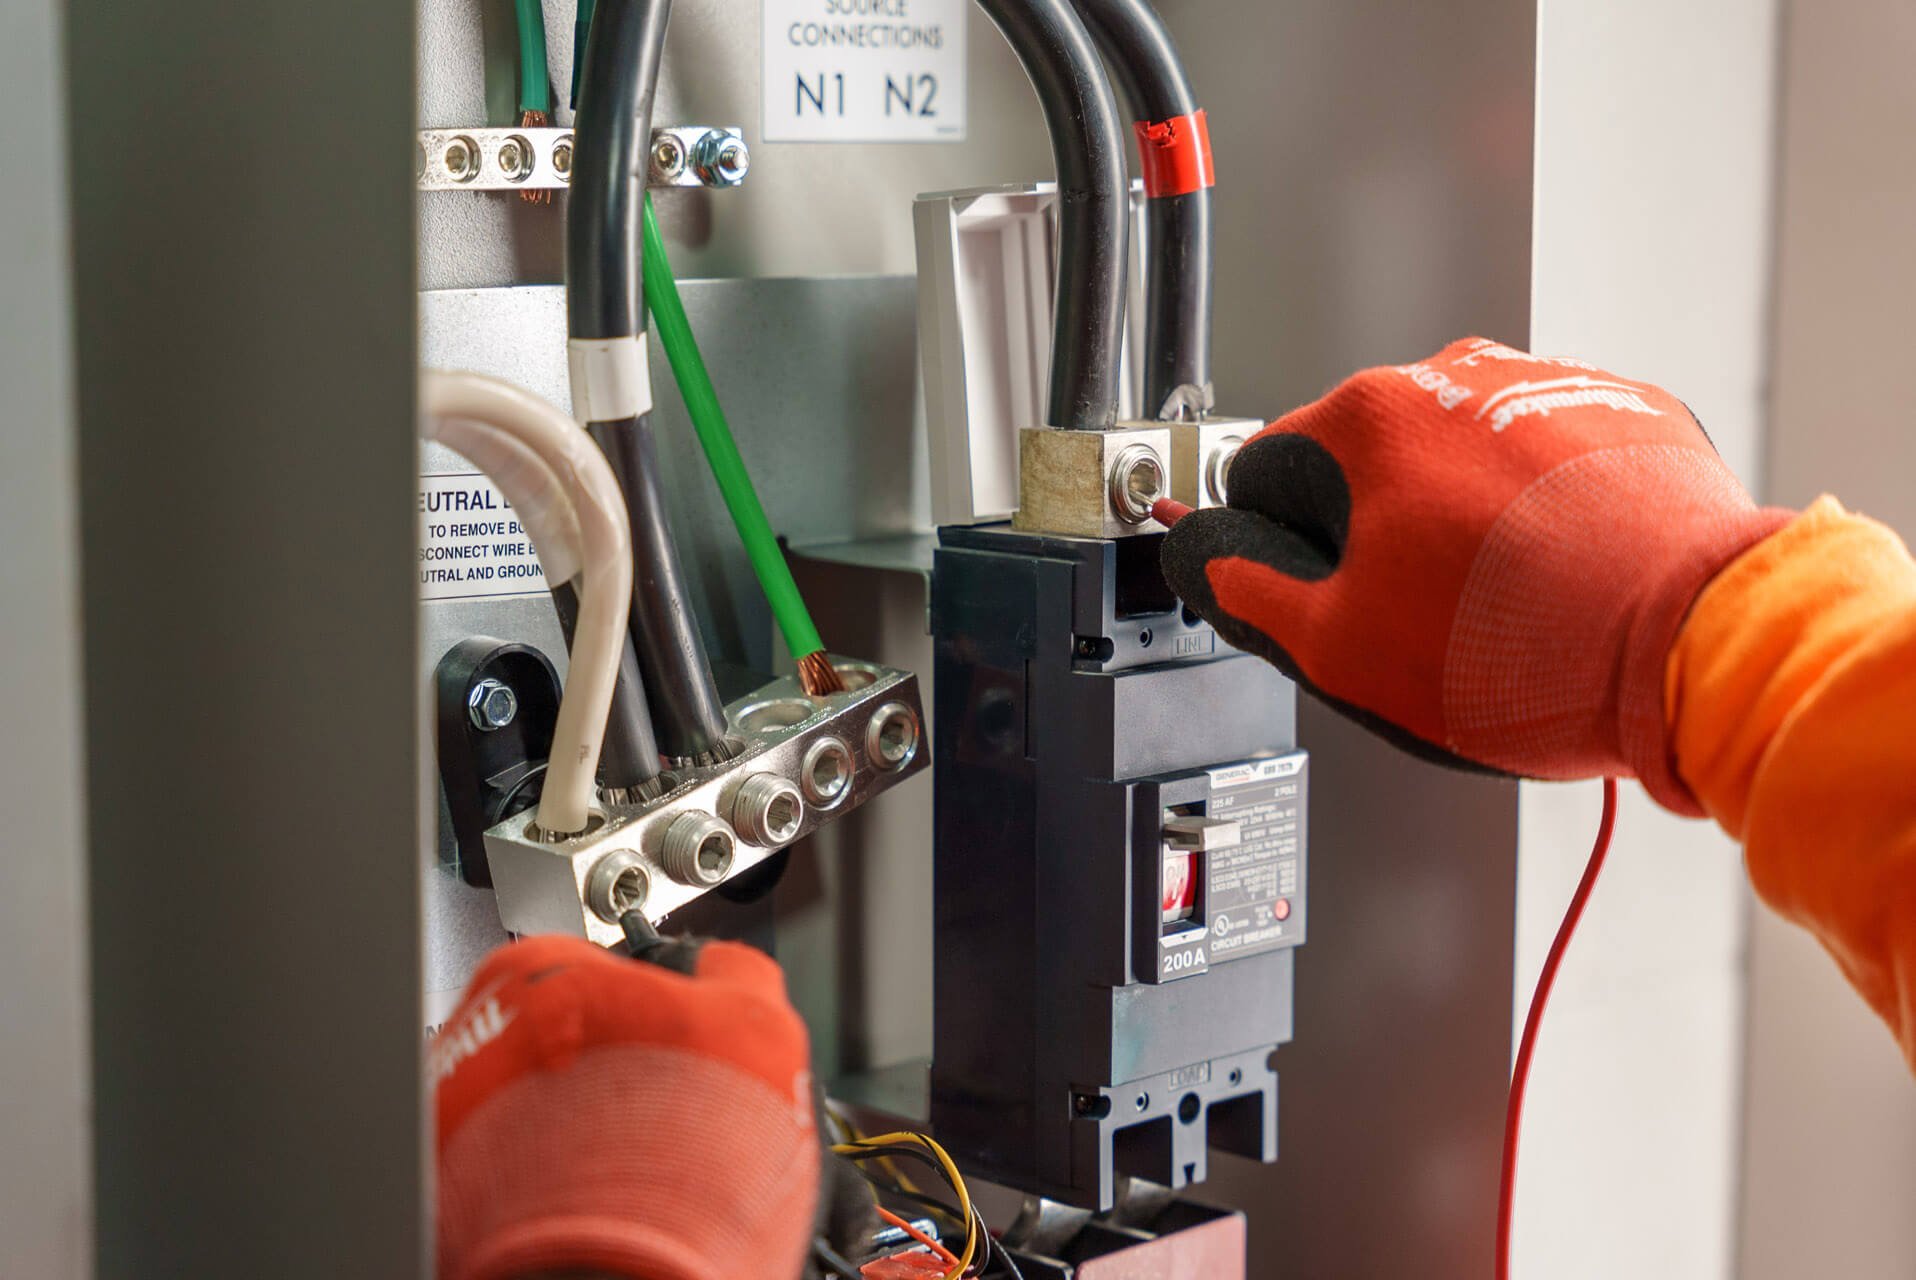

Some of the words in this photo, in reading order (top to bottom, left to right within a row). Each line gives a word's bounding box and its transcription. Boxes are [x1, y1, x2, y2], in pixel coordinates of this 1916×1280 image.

[825, 0, 908, 16] SOURCE
[788, 22, 943, 49] CONNECTIONS
[796, 72, 844, 116] N1
[885, 74, 938, 117] N2
[419, 490, 497, 512] EUTRAL
[429, 524, 446, 538] TO
[450, 522, 504, 537] REMOVE
[419, 543, 489, 561] SCONNECT
[492, 543, 525, 557] WIRE
[420, 568, 464, 583] UTRAL
[467, 566, 494, 580] AND
[498, 564, 543, 578] GROUN
[1210, 935, 1242, 952] CIRCUIT
